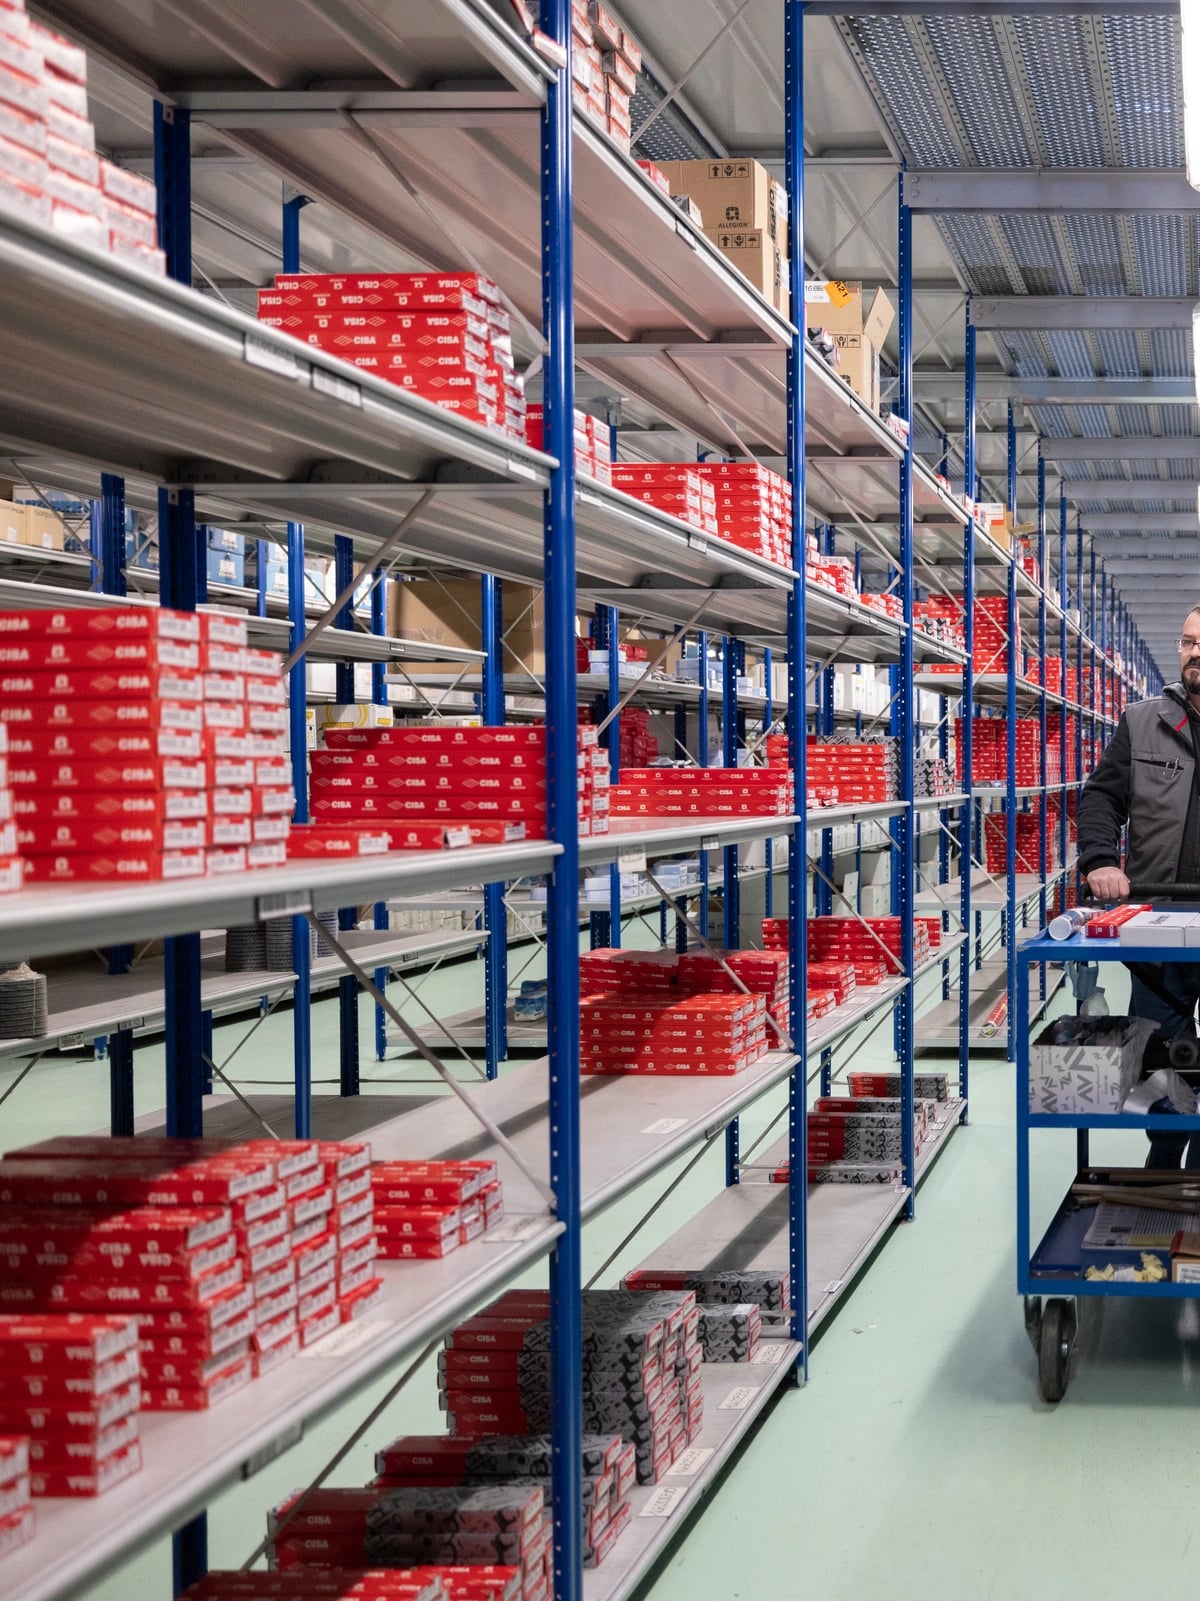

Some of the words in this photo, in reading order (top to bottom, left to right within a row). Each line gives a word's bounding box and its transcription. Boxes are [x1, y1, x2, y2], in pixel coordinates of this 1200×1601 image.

[437, 336, 459, 344] CISA
[355, 358, 377, 366] CISA
[438, 357, 460, 365] CISA
[449, 378, 471, 386] CISA
[116, 616, 148, 628] CISA
[115, 646, 146, 658] CISA
[2, 678, 33, 692] CISA
[118, 676, 150, 688] CISA
[0, 708, 32, 722] CISA
[117, 706, 148, 720] CISA
[118, 738, 150, 750] CISA
[122, 768, 154, 781] CISA
[123, 798, 154, 812] CISA
[121, 829, 152, 842] CISA
[326, 840, 350, 850] CISA
[117, 860, 148, 872] CISA
[388, 1190, 410, 1198] CISA
[108, 1287, 140, 1300] CISA
[480, 1414, 498, 1422] CISA
[412, 1457, 432, 1465] CISA
[308, 1516, 331, 1524] CISA
[305, 1540, 328, 1548] CISA
